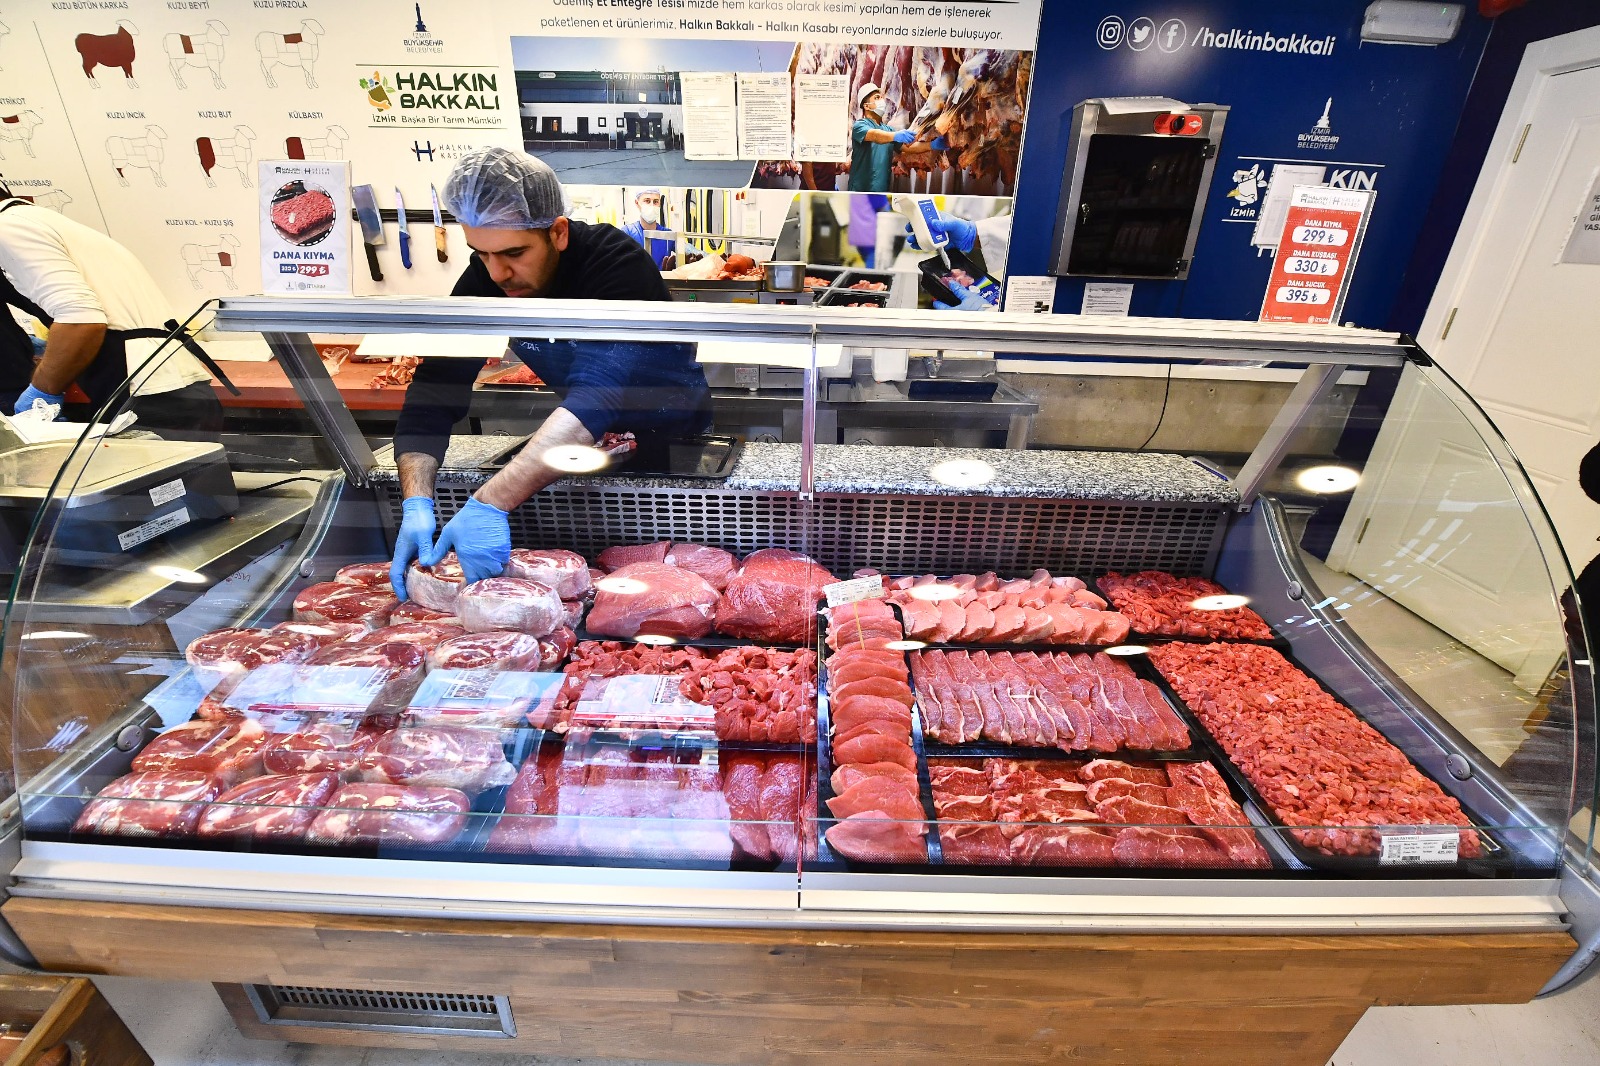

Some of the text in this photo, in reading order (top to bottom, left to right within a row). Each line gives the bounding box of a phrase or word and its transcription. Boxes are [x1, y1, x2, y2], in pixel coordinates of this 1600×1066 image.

[52, 2, 72, 10] KUZU
[73, 1, 98, 9] BÜTÜN
[167, 1, 186, 9] KUZU
[253, 0, 274, 8] KUZU
[722, 0, 749, 10] hem
[749, 0, 784, 11] karkas
[787, 1, 820, 12] olarak
[823, 2, 856, 13] kesimi
[859, 4, 899, 16] yapılan
[902, 4, 925, 16] hem
[927, 6, 942, 16] de
[944, 6, 991, 18] işlenerek
[541, 17, 600, 28] paketlenen
[602, 18, 613, 28] et
[679, 19, 713, 30] Halkın
[716, 20, 755, 31] Bakkalı
[766, 21, 799, 32] Halkın
[802, 22, 839, 34] Kasabı
[841, 25, 909, 37] reyonlarında
[911, 26, 947, 38] sizlerle
[950, 28, 1003, 42] buluşuyor.
[1191, 27, 1337, 56] /halkinbakkali
[395, 72, 498, 92] HALKIN
[400, 94, 500, 110] BAKKALI
[106, 111, 125, 119] KUZU
[198, 110, 232, 118] KUZU BUT
[288, 110, 324, 119] KÜLBASTI
[372, 114, 502, 125] İZMİR Başka Bir Tarım Mümkün
[1230, 207, 1256, 217] İZMİR
[1304, 219, 1342, 229] DANA KIYMA
[1302, 229, 1326, 242] 299
[273, 251, 335, 260] DANA KIYMA
[1293, 249, 1338, 260] DANA KUŞBAŞI
[300, 265, 317, 274] 299
[1294, 259, 1319, 273] 330
[1305, 280, 1327, 289] SUCUK
[1286, 289, 1309, 302] 395
